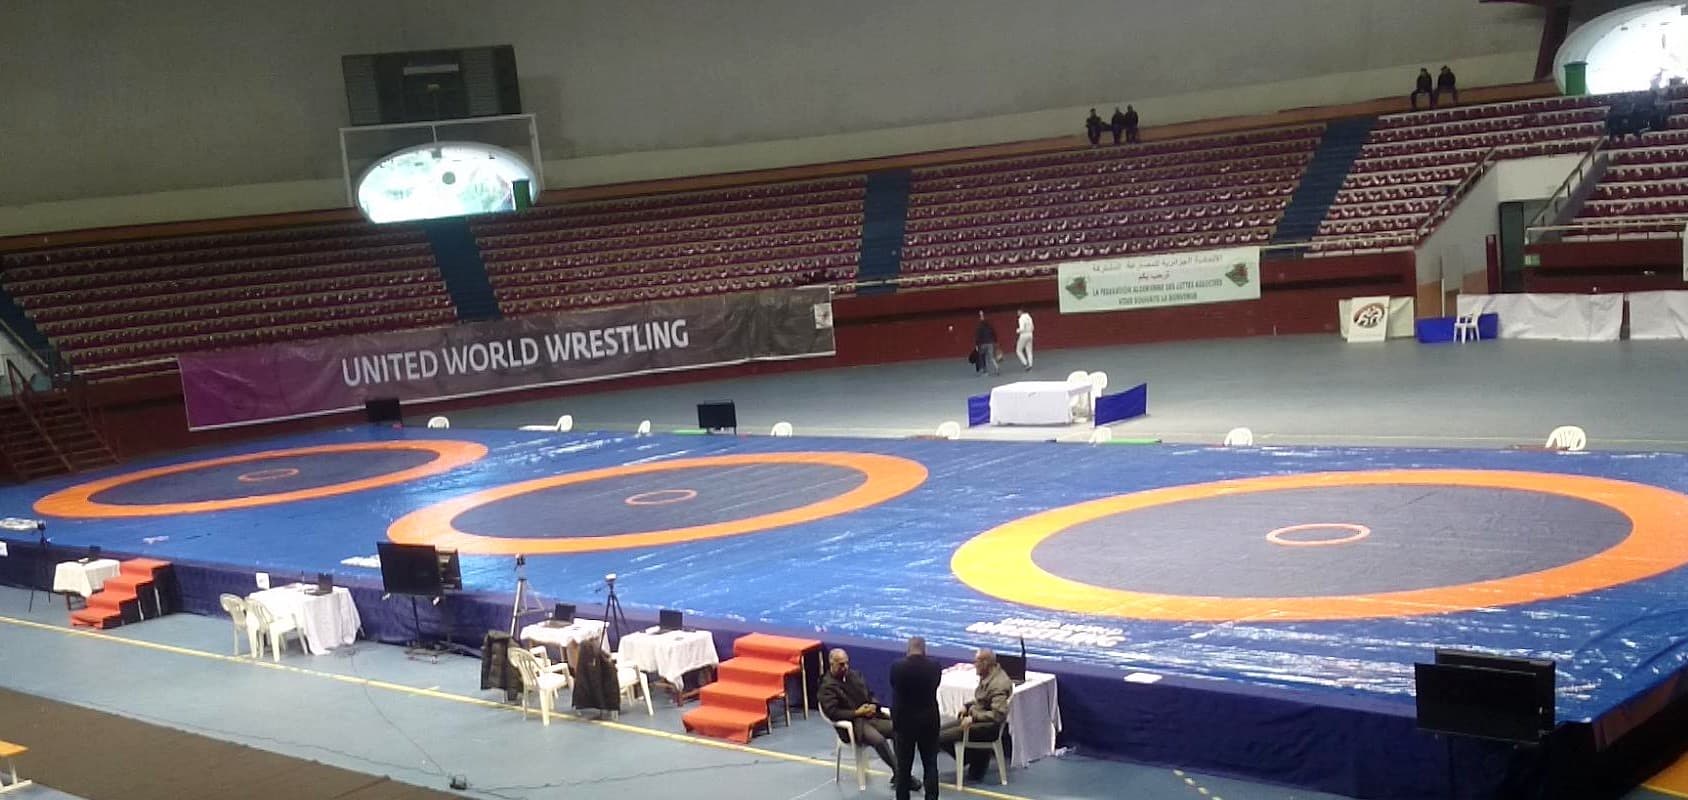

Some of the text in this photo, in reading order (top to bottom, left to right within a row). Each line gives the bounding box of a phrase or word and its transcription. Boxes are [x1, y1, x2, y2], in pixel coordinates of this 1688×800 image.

[342, 319, 689, 386] UNITED WORLD WRESTLING
